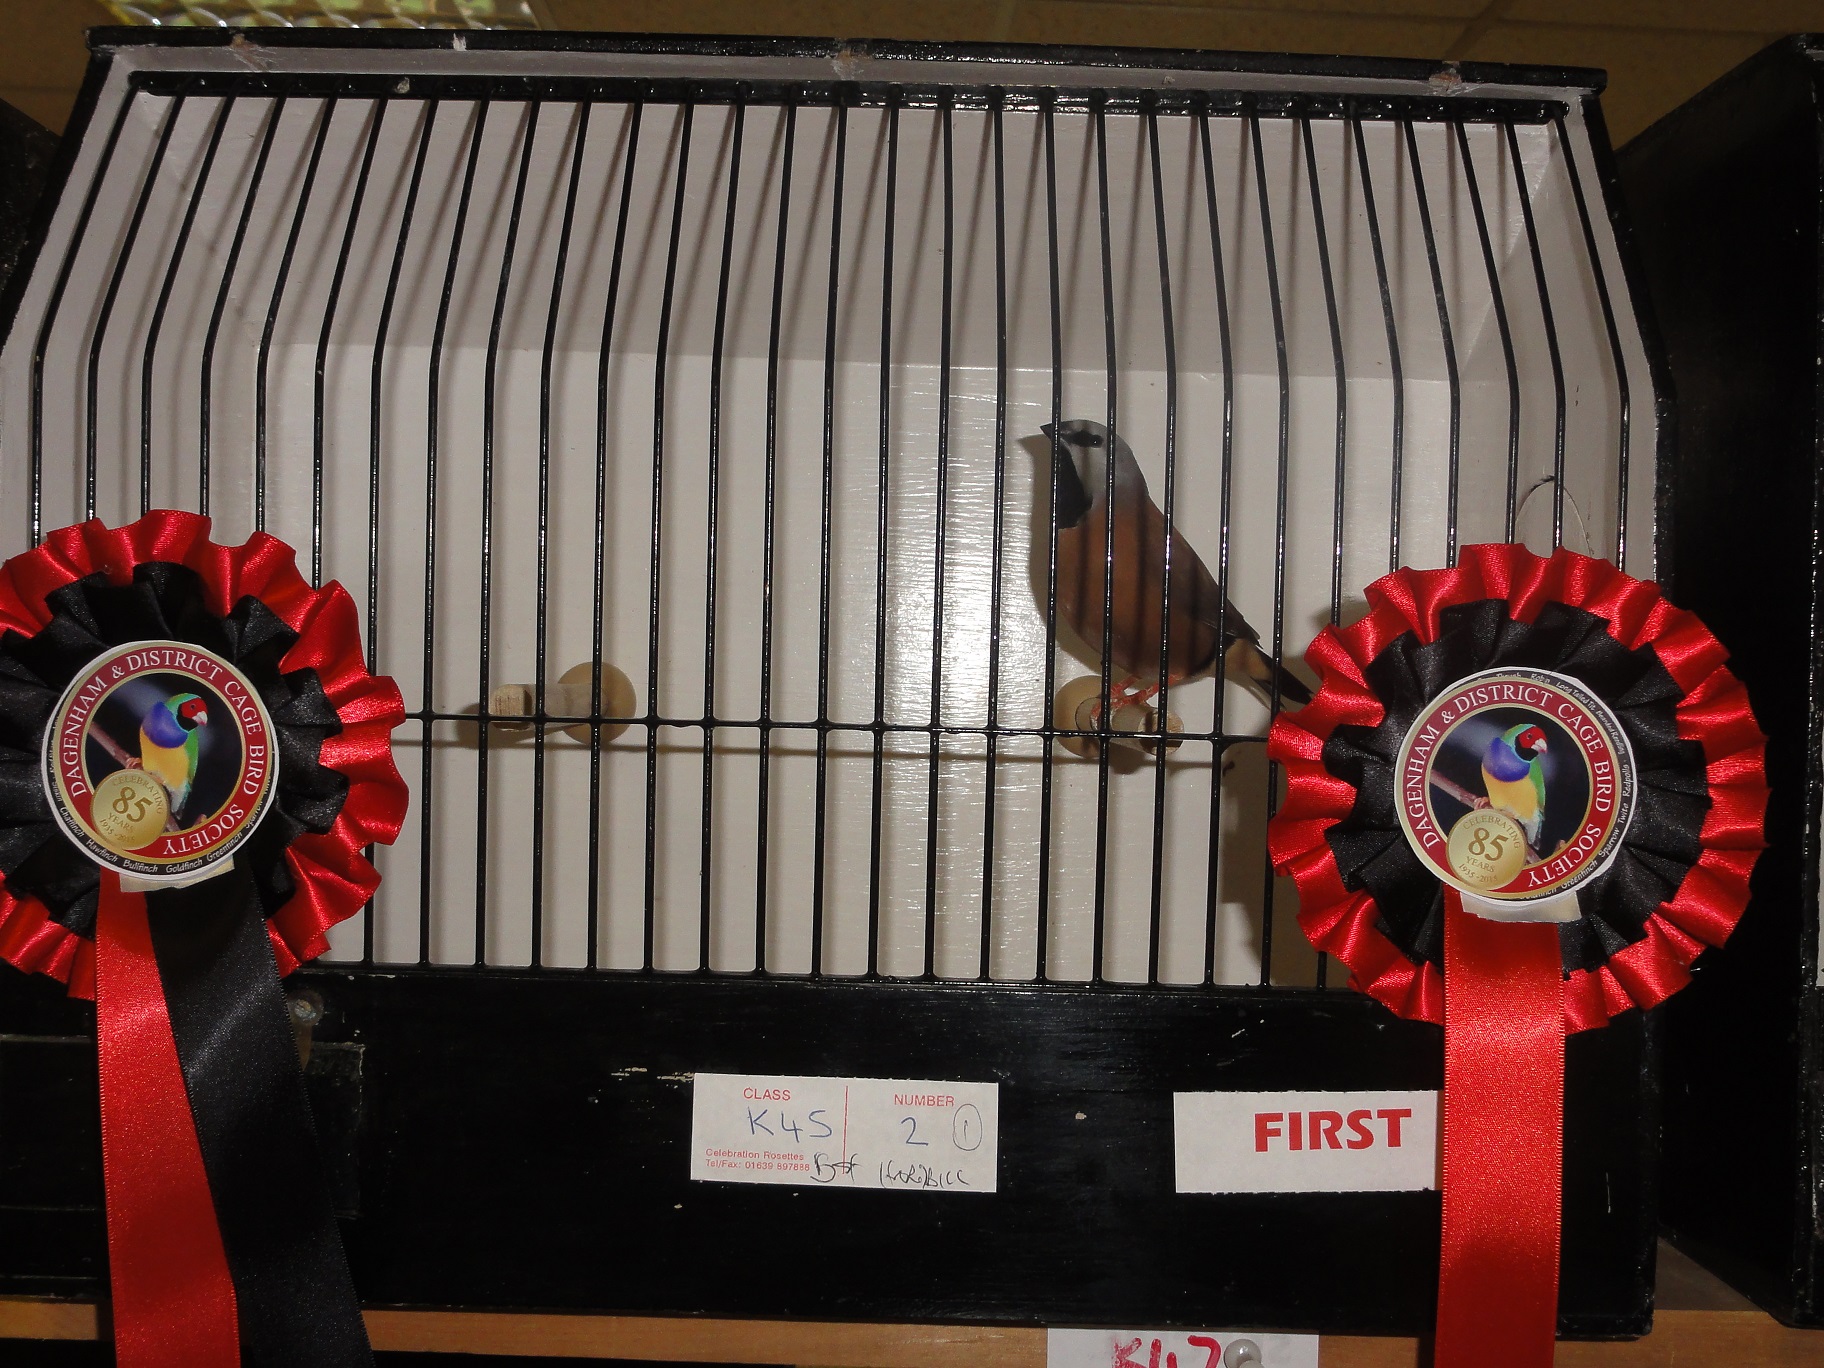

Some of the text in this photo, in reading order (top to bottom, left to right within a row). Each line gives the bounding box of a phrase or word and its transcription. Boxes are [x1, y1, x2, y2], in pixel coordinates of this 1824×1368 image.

[111, 665, 125, 679] &
[125, 650, 223, 681] DISTRICT
[224, 681, 262, 735] CAGE
[63, 676, 108, 797] DAGENHAM
[243, 744, 264, 795] BIRD
[1406, 684, 1612, 888] DAGENHAM & DISTRICT CAGE BIRD SOCIETY
[112, 775, 165, 814] CELEBRATING
[112, 786, 153, 823] 85
[108, 812, 134, 833] YEARS
[163, 804, 244, 855] SOCIETY
[1463, 815, 1521, 849] CELEBRATING
[86, 839, 118, 863] Hawfinch
[123, 859, 158, 873] Bullfinch
[166, 858, 203, 873] Goldfinch
[1468, 827, 1509, 861] 85
[1598, 827, 1620, 858] Sparrow
[1466, 856, 1494, 872] YEARS
[743, 1087, 791, 1101] CLASS
[894, 1094, 955, 1108] NUMBER
[901, 1116, 929, 1146] 2
[1254, 1108, 1412, 1152] FIRST
[705, 1148, 804, 1161] Celebration Rosettes
[705, 1159, 810, 1172] Tel/Fax: 01639 897888
